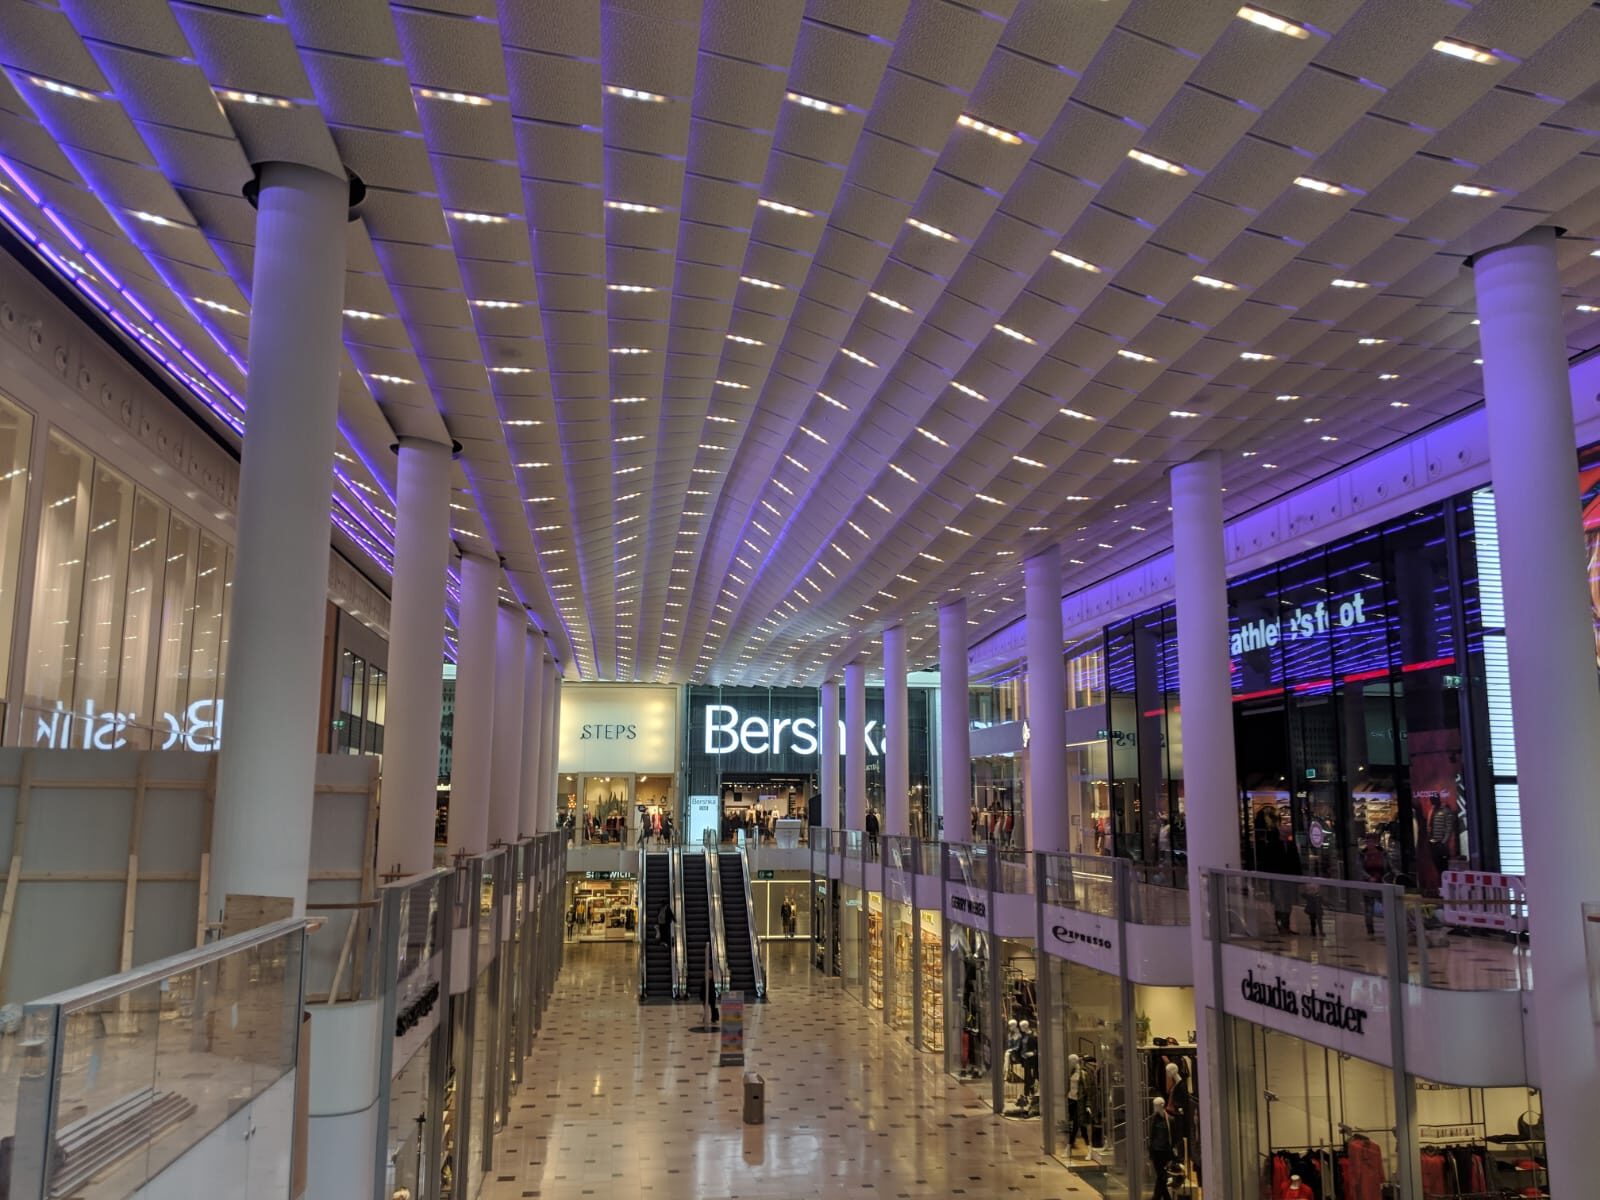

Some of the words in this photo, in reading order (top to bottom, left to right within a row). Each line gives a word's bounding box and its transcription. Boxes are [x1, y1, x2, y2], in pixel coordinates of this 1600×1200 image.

[580, 724, 636, 739] STEPS
[705, 704, 886, 756] Bershk
[1241, 969, 1298, 1015] claudia
[1301, 989, 1367, 1035] sträter
